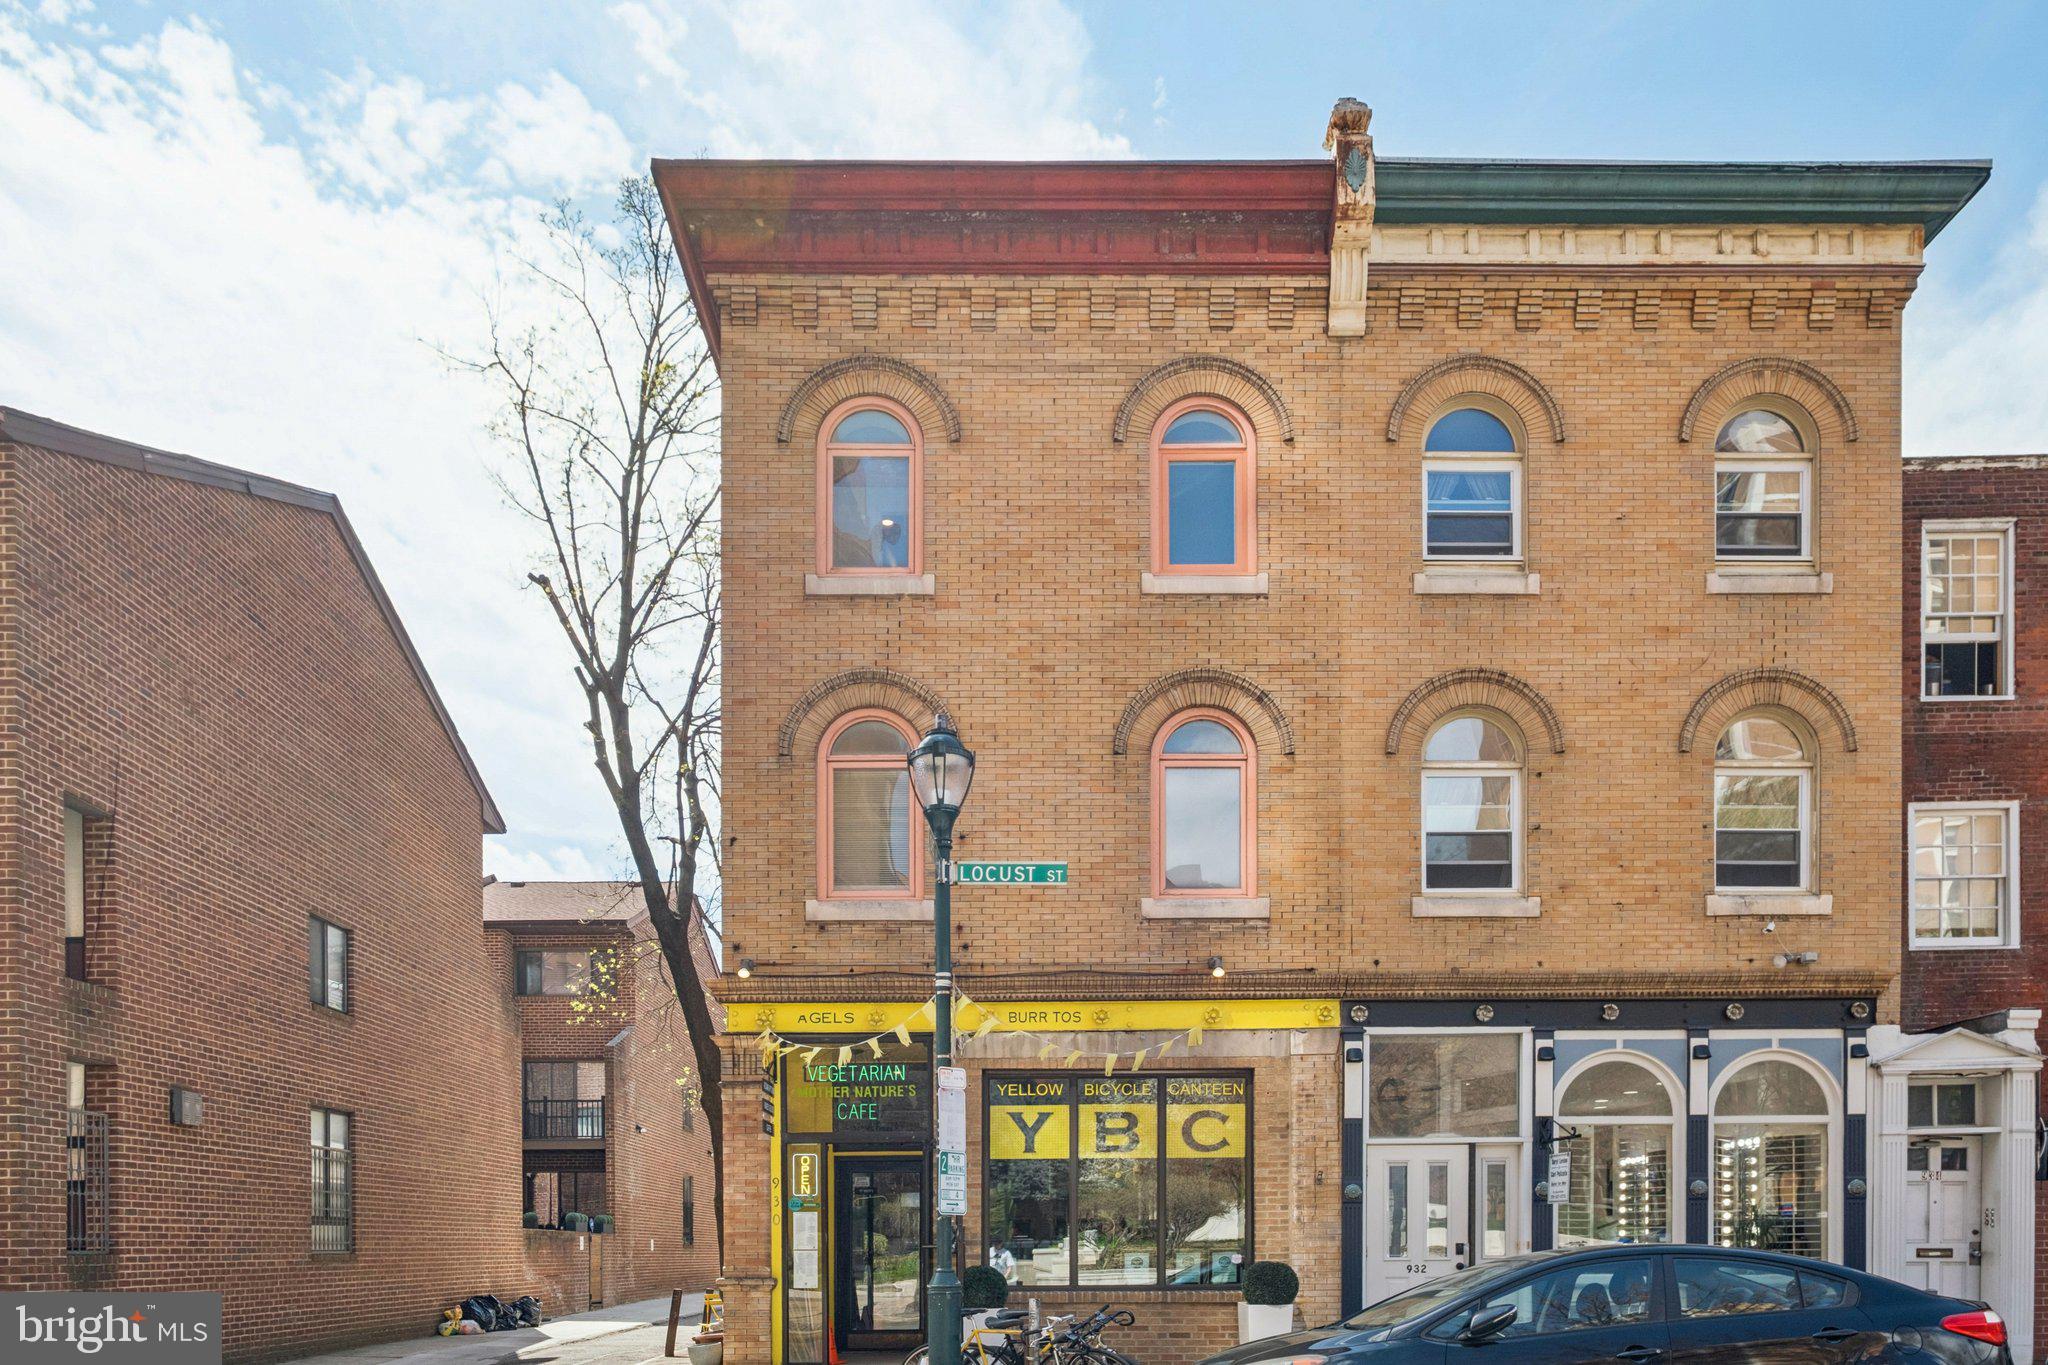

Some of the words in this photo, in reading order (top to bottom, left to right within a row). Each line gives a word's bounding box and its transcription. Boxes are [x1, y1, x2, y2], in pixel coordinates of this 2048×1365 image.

[960, 866, 1036, 882] LOCUST
[1047, 870, 1063, 882] ST
[807, 1064, 906, 1082] VEGETARIAN
[855, 1084, 917, 1098] NATURE'S
[997, 1083, 1064, 1096] YELLOW
[1084, 1083, 1152, 1096] BICYCLE
[1168, 1083, 1245, 1096] CANTEEN
[837, 1103, 878, 1120] CAFE
[941, 1155, 947, 1171] 2
[800, 1155, 811, 1195] OPEN
[1406, 1264, 1426, 1273] 932
